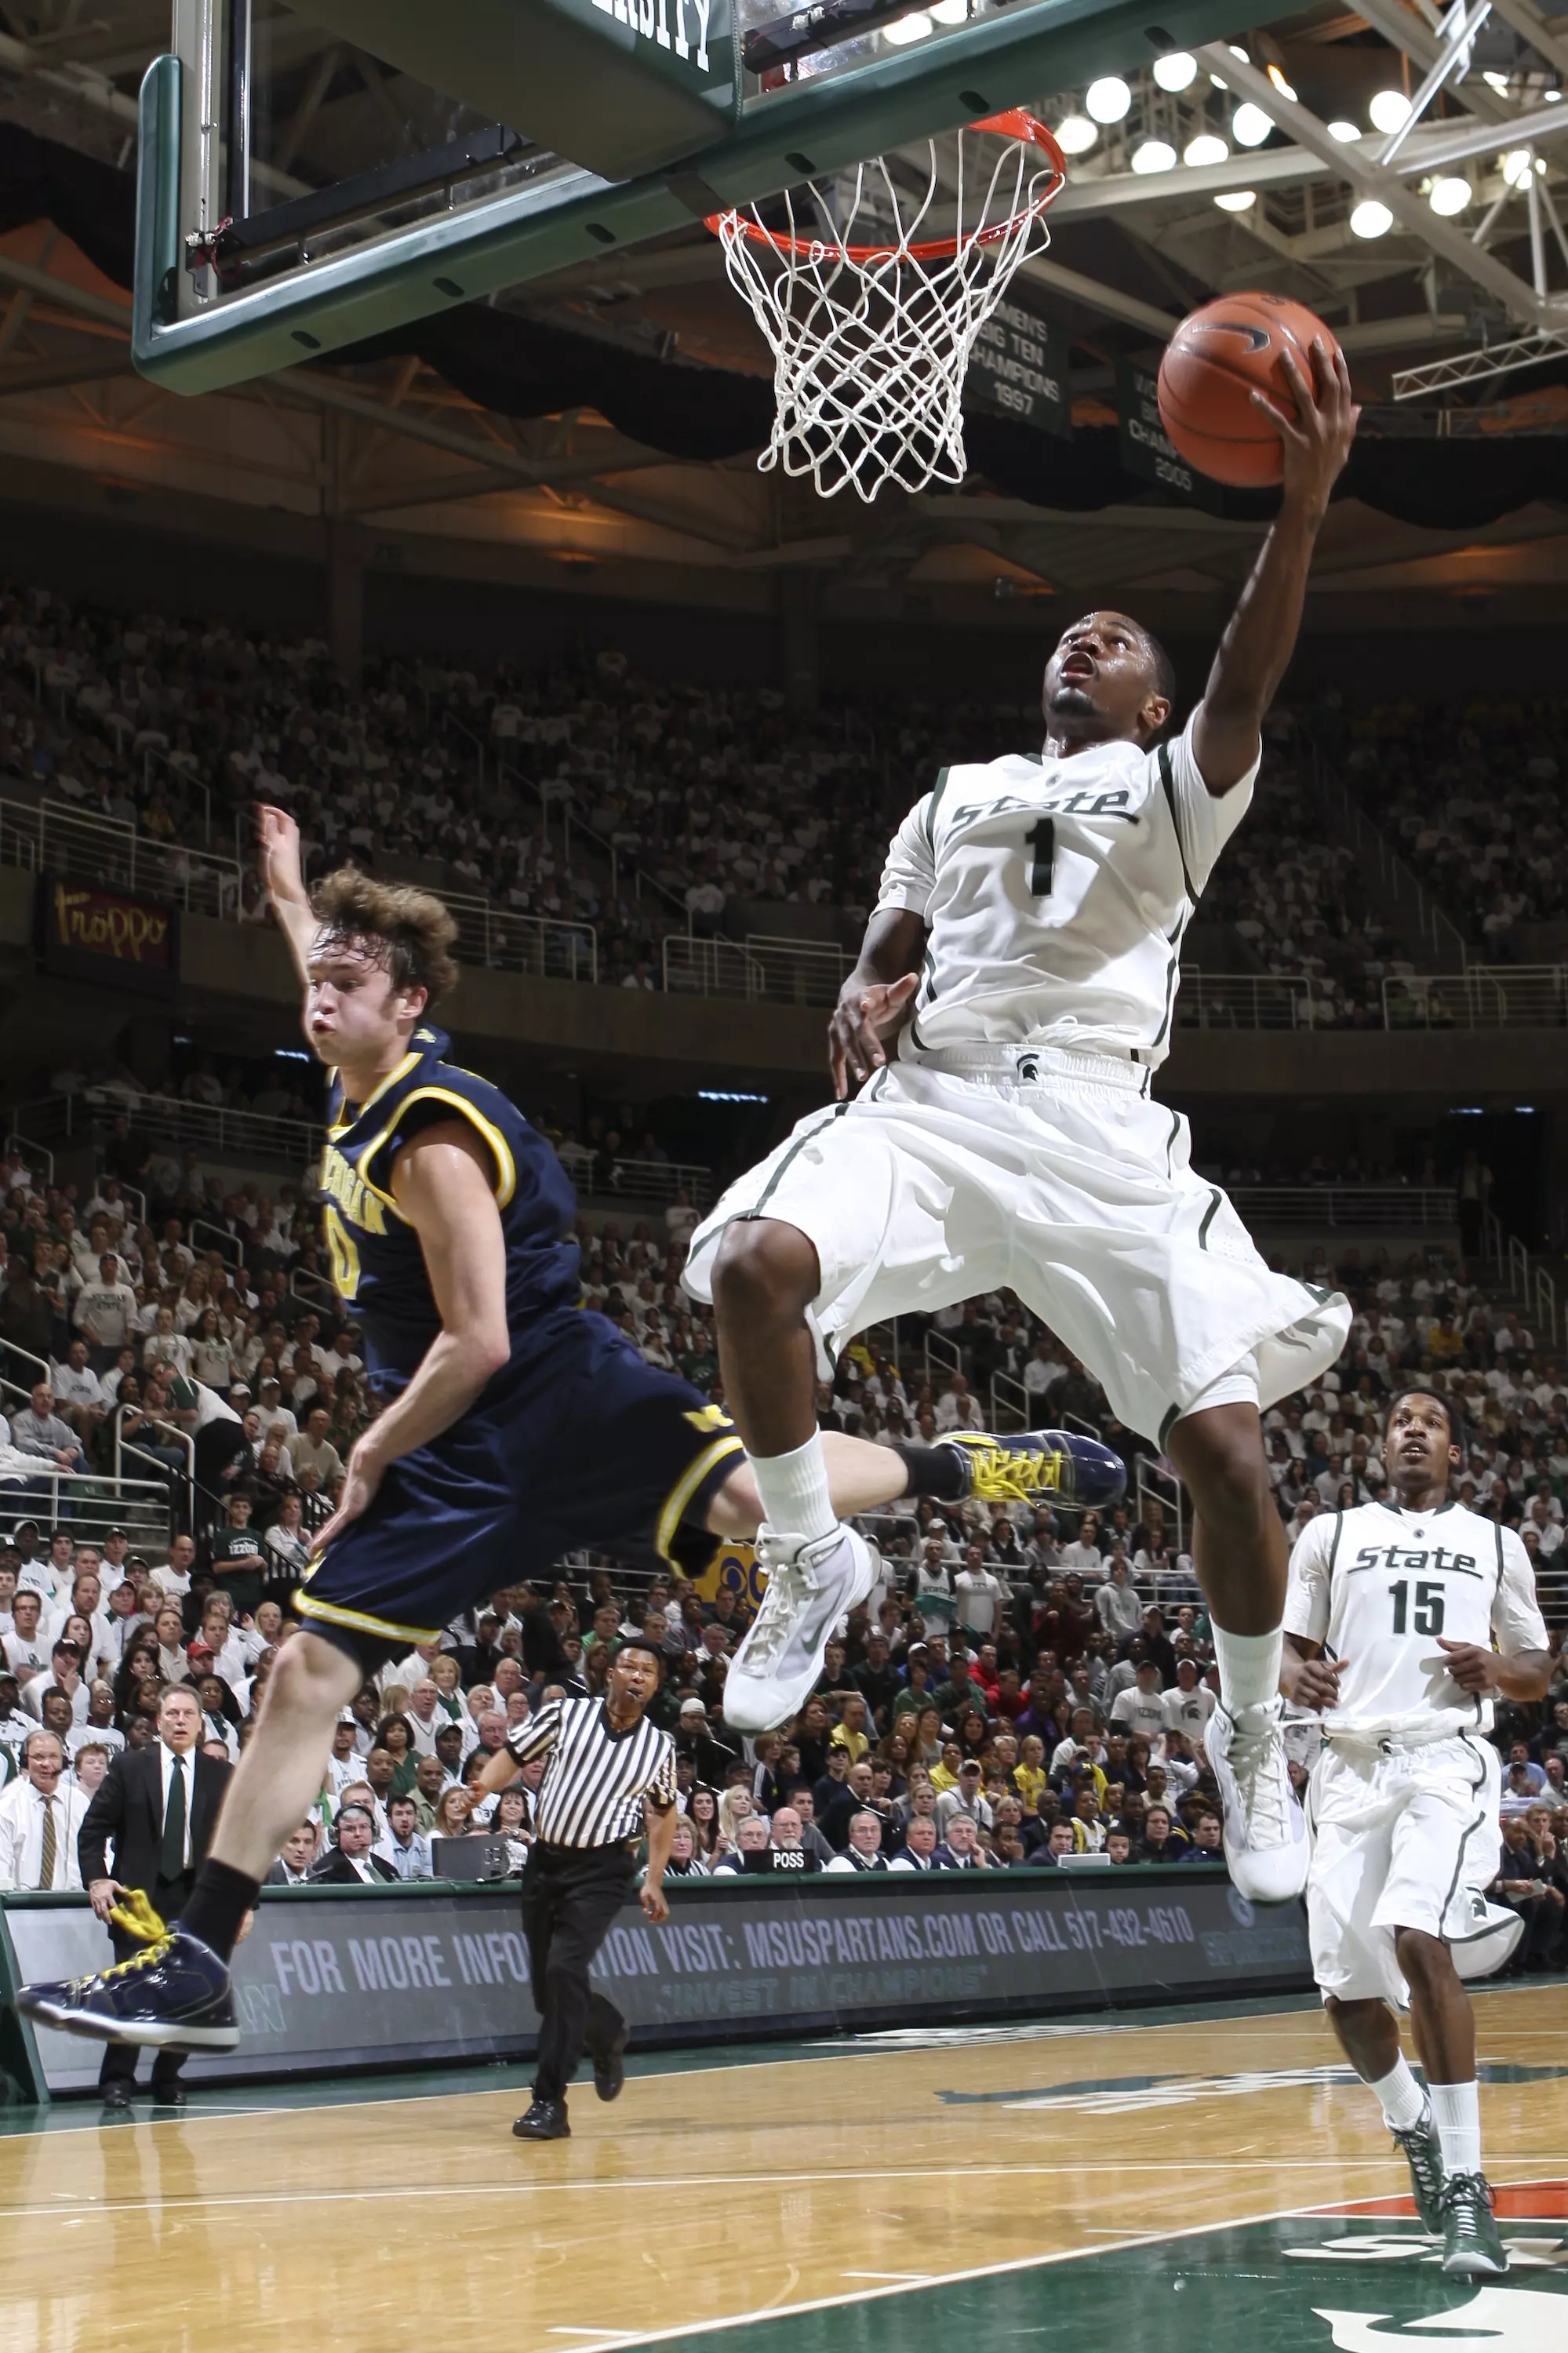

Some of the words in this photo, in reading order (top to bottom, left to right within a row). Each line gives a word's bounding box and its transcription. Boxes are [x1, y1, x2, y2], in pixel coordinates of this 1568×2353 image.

[1010, 332, 1045, 368] TEN
[994, 381, 1034, 415] 1997
[1024, 817, 1055, 898] 1
[1388, 1579, 1446, 1637] 15
[773, 1852, 805, 1868] POSS
[269, 1940, 347, 1995] FOR
[347, 1935, 453, 1991] MORE
[657, 1923, 742, 1973] VISIT:
[743, 1912, 980, 1969] MSUSPARTANS.COM
[977, 1911, 1016, 1955] OR
[1011, 1910, 1069, 1953] CALL
[1063, 1906, 1195, 1951] 517-432-4610
